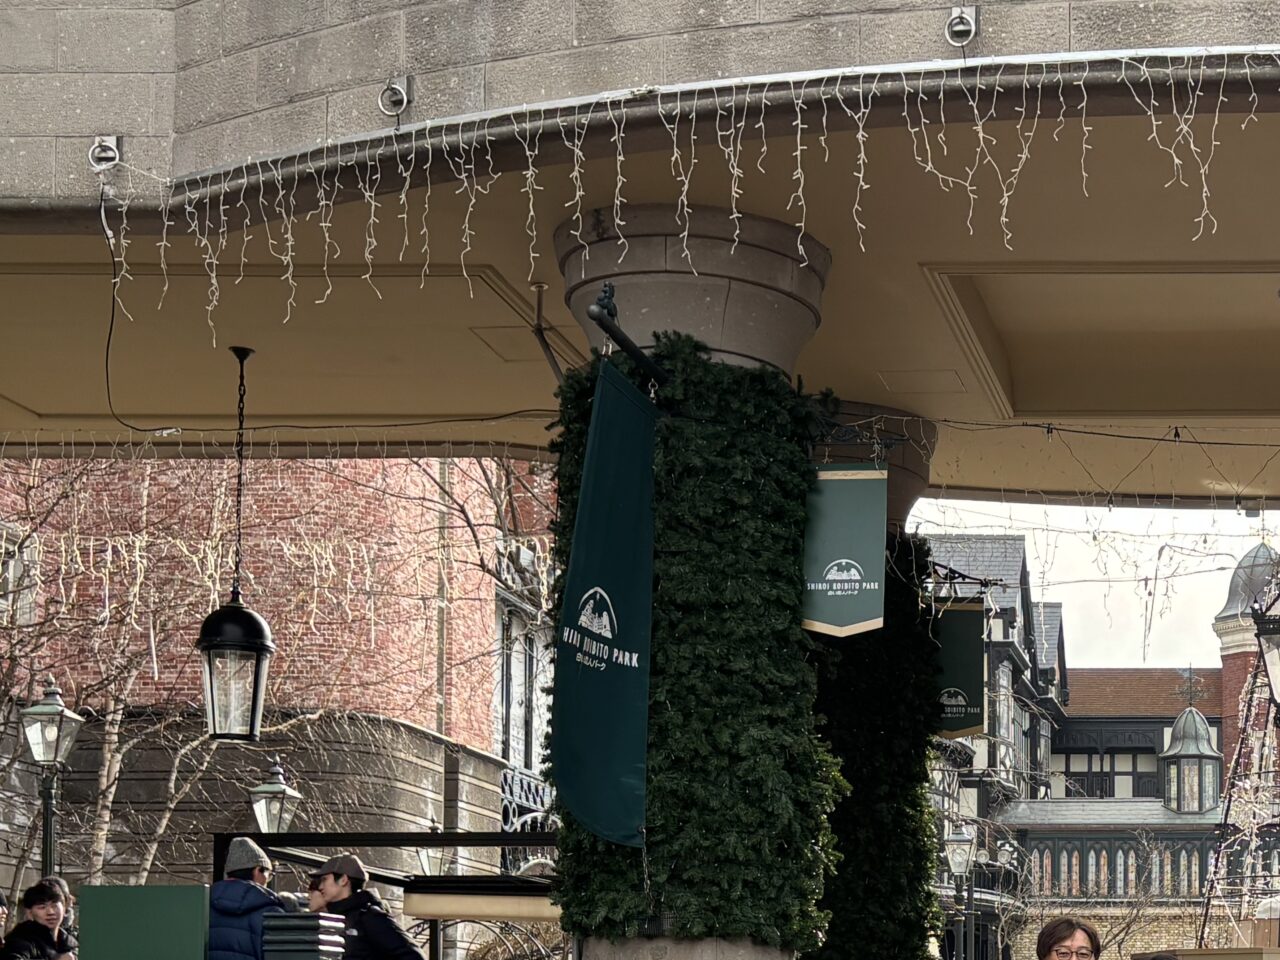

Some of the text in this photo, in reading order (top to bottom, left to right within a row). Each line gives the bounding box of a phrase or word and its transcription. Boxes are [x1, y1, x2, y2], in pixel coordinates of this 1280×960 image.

[807, 582, 879, 590] SHIROI KOIBITO PARK
[612, 648, 639, 668] PARK
